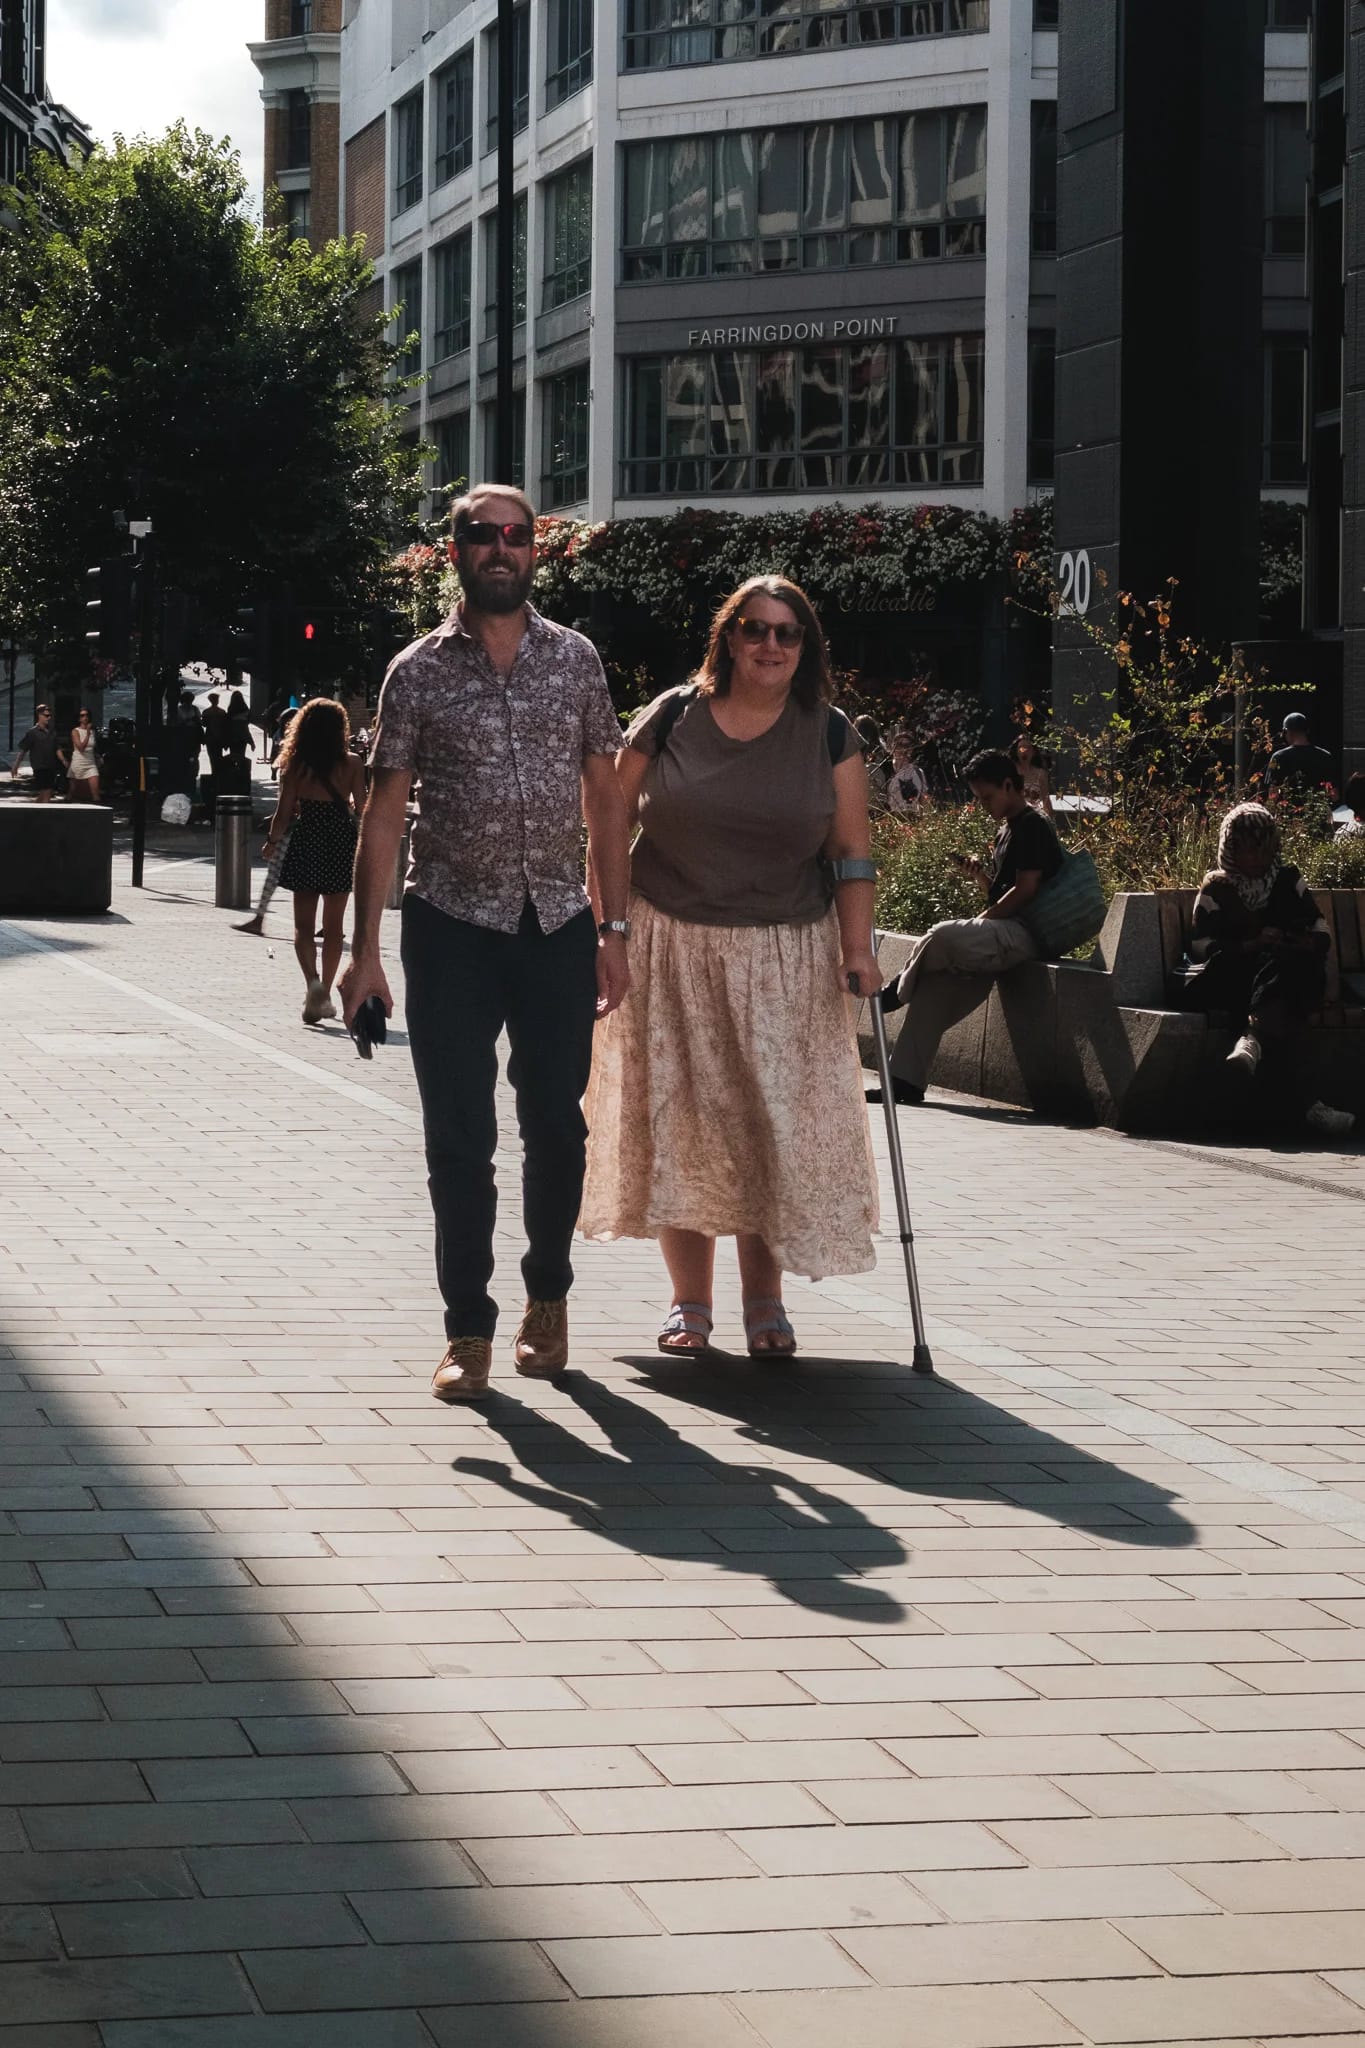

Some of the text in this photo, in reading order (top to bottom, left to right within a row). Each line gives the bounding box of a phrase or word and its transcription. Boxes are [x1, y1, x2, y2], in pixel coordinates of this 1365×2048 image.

[688, 316, 897, 345] FARRINGDON POINT
[1059, 549, 1090, 616] 20
